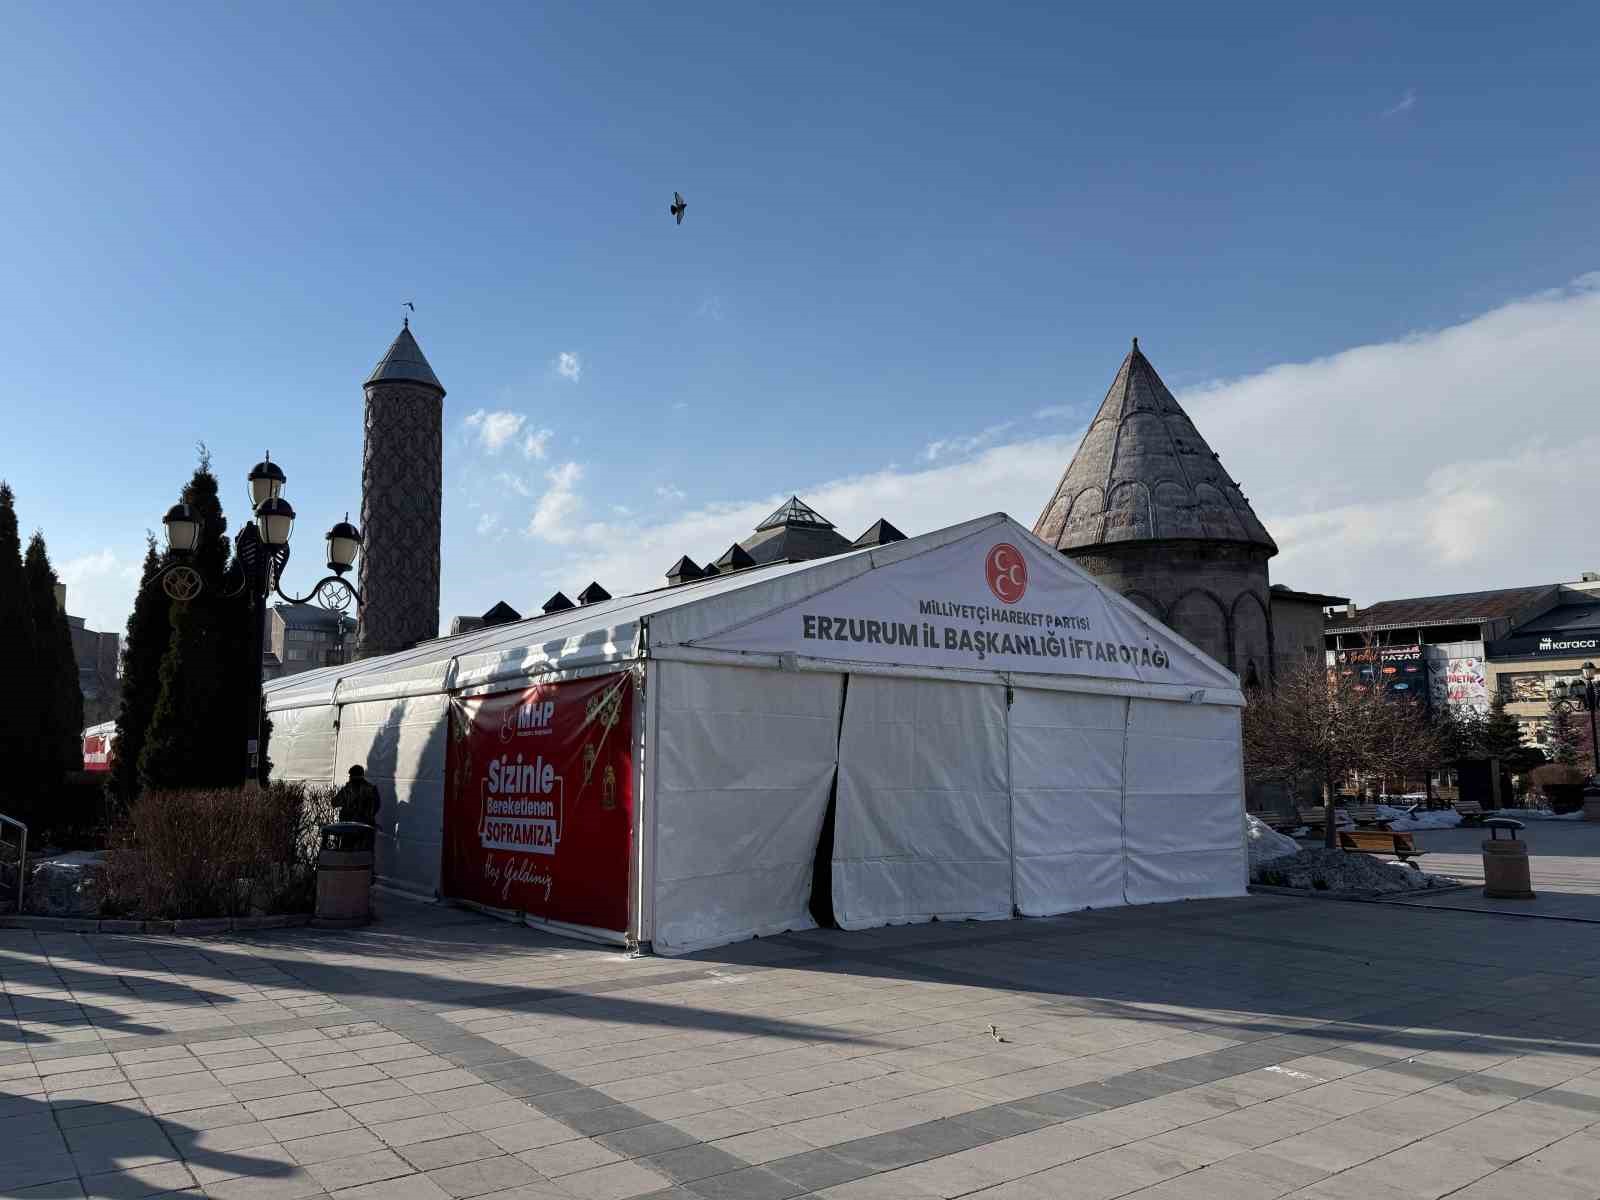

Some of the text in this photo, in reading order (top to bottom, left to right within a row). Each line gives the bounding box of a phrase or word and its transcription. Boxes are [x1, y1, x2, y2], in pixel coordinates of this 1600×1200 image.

[920, 599, 990, 625] MİLLİYETÇİ
[991, 607, 1043, 627] HAREKET
[802, 614, 1170, 670] ERZURUM İL BAŞKANLIĞI İFTAR OTAĞI
[1381, 652, 1420, 662] PAZAR
[517, 701, 555, 729] MHP
[487, 753, 555, 795] Sizinle
[486, 796, 554, 817] Bereketlenen
[486, 822, 554, 848] SOFRAMIZA
